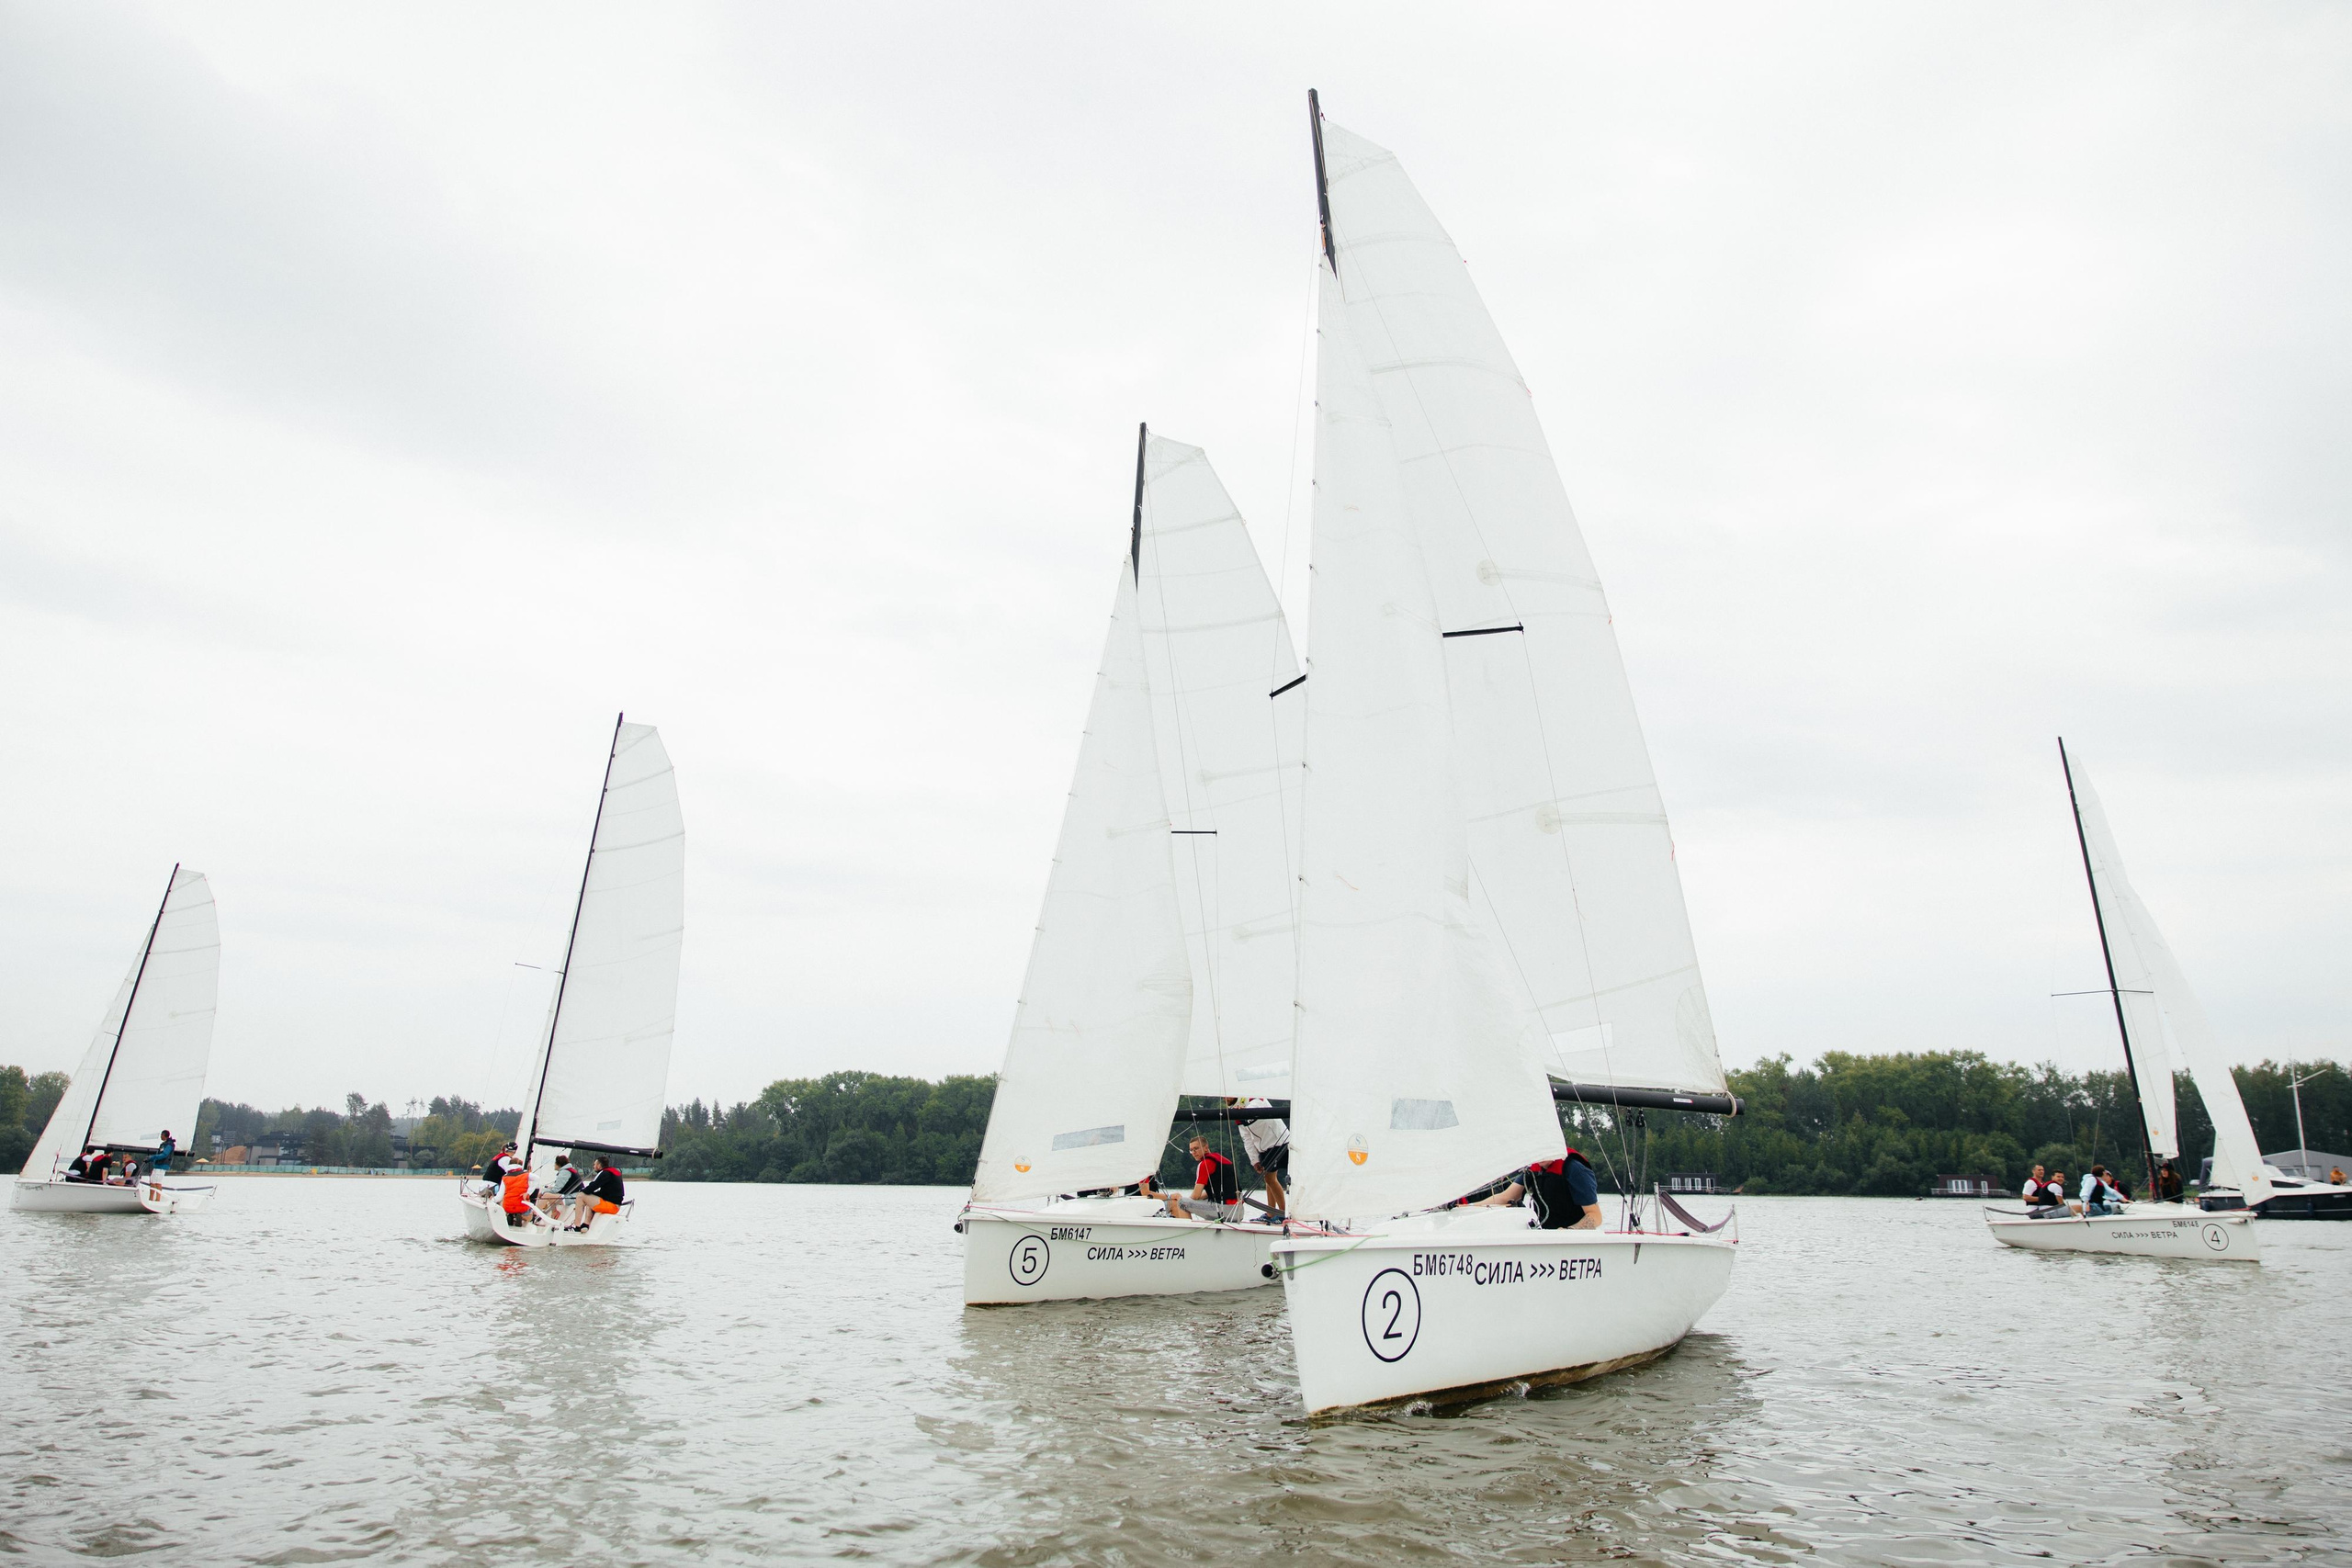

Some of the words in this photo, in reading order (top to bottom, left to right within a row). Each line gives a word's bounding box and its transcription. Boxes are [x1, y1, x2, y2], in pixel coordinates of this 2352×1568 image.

[1050, 1227, 1092, 1241] БМ6147
[2111, 1231, 2133, 1239] СИЛА
[2151, 1231, 2178, 1239] ВЕТРА
[2211, 1230, 2221, 1245] 4
[1022, 1247, 1037, 1274] 5
[1087, 1247, 1124, 1260] СИЛА
[1149, 1247, 1185, 1260] ВЕТРА
[1413, 1253, 1474, 1277] БМ6748
[1474, 1260, 1524, 1286] СИЛА
[1558, 1258, 1602, 1280] ВЕТРА
[1382, 1290, 1403, 1340] 2
